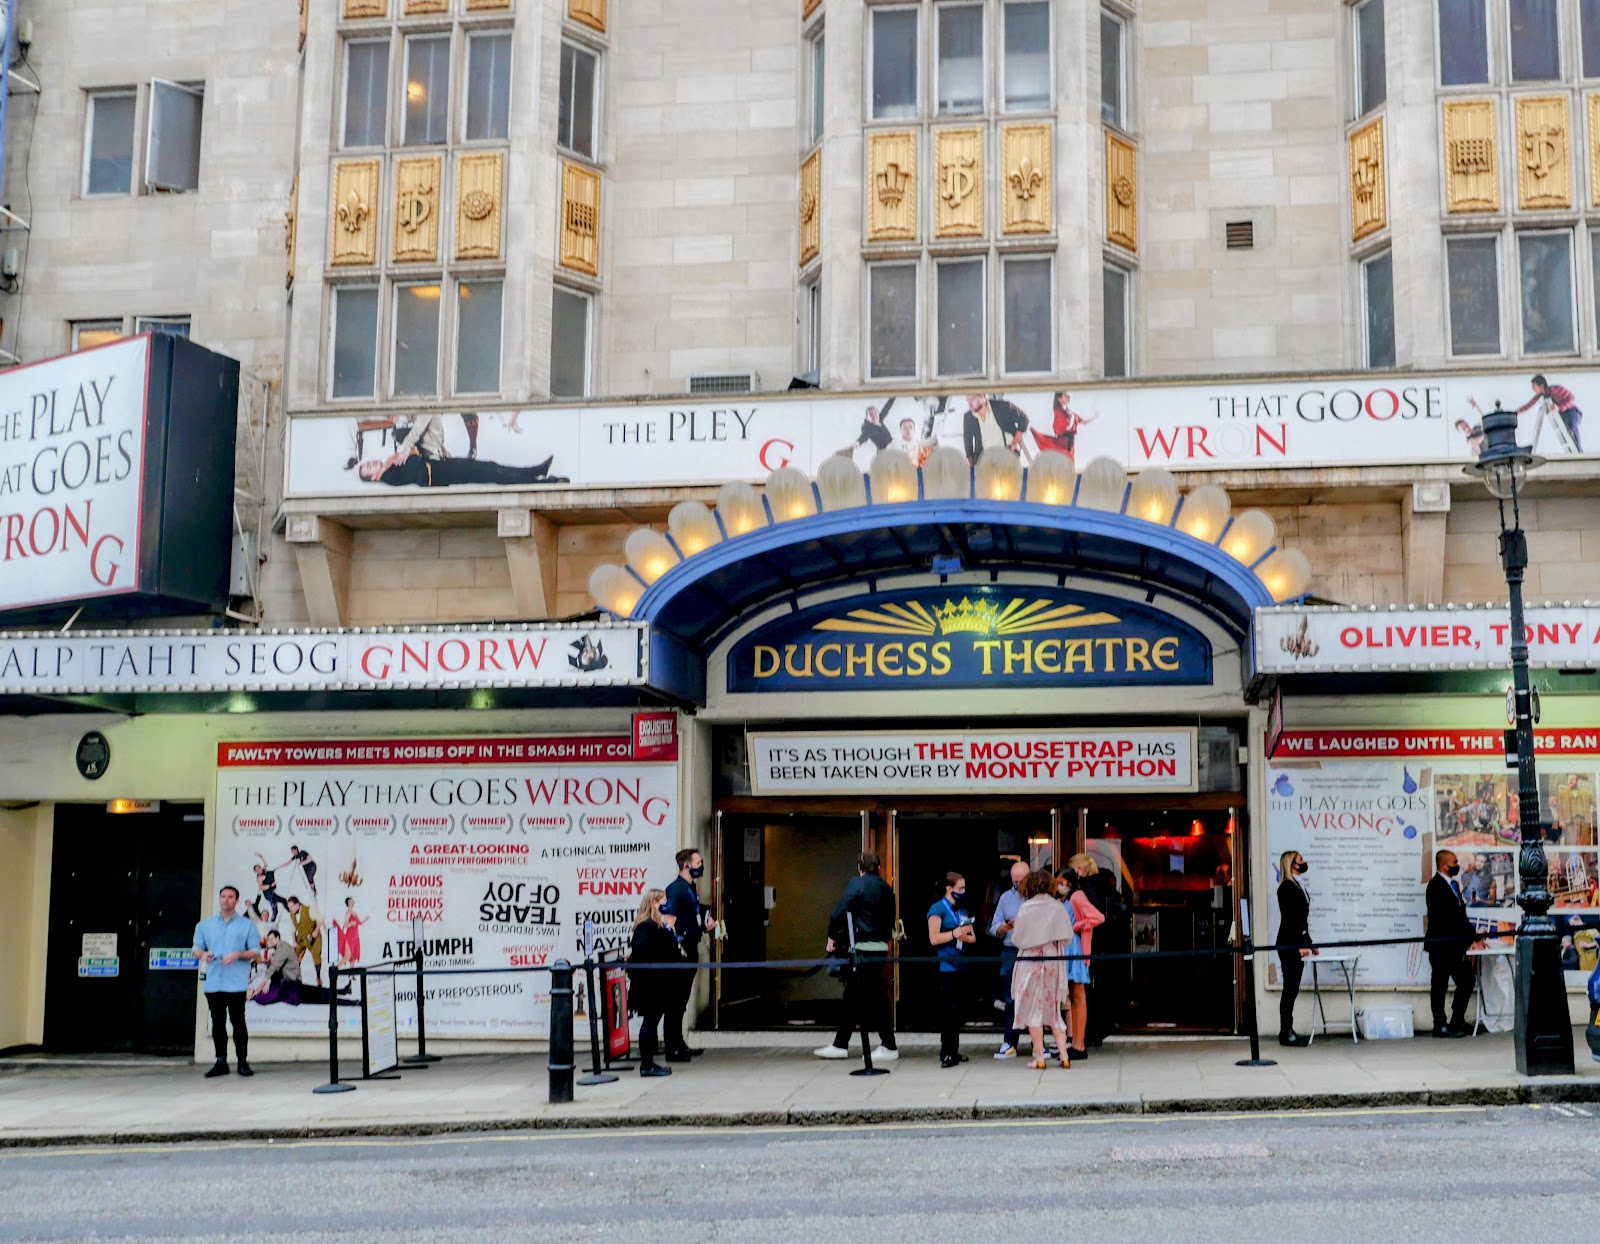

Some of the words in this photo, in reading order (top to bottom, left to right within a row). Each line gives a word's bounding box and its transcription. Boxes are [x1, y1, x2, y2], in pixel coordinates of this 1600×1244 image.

[30, 375, 116, 441] PLAY
[1210, 396, 1289, 419] THAT
[1296, 386, 1442, 422] GOOSE
[603, 423, 657, 444] THE
[668, 408, 758, 442] PLEY
[31, 430, 133, 495] GOES
[0, 499, 124, 587] RONG
[1340, 625, 1480, 650] OLIVIER,
[2, 645, 73, 678] ALP
[91, 643, 207, 677] TAHT
[225, 641, 339, 676] SEOG
[360, 637, 549, 680] GNORW
[753, 641, 952, 678] DUCHESS
[974, 637, 1180, 676] THEATRE
[1319, 736, 1399, 750] LAUGHED
[1404, 736, 1455, 749] UNTIL
[1460, 735, 1494, 749] THE
[1498, 735, 1555, 749] TRS
[1560, 735, 1597, 749] RAN
[227, 749, 282, 761] FAWLTY
[285, 747, 343, 760] TOWERS
[346, 747, 391, 759] MEETS
[394, 746, 444, 758] NOISES
[447, 745, 475, 758] OFF
[478, 745, 493, 757] IN
[497, 745, 524, 757] THE
[527, 744, 576, 757] SMASH
[580, 744, 602, 756] HIT
[804, 748, 828, 762] AS
[831, 747, 911, 762] THOUGH
[914, 743, 965, 761] THE
[970, 741, 1134, 760] MOUSETRAP
[1137, 741, 1176, 757] HAS
[769, 765, 816, 780] BEEN
[821, 765, 878, 779] TAKEN
[883, 764, 932, 779] OVER
[937, 764, 960, 778] BY
[965, 761, 1059, 780] MONTY
[1067, 759, 1176, 778] PYTHON
[229, 786, 276, 806] THE
[283, 779, 354, 807] PLAY
[359, 783, 424, 804] THAT
[430, 778, 517, 807] GOES
[525, 776, 670, 827] WRONG
[1299, 795, 1340, 811] PLAY
[1343, 800, 1373, 811] THAT
[1377, 795, 1427, 812] GOES
[239, 819, 275, 827] WINNER
[295, 819, 332, 827] WINNER
[352, 818, 389, 827] WINNER
[410, 817, 448, 826] WINNER
[468, 816, 506, 826] WINNER
[526, 816, 565, 826] WINNER
[586, 816, 625, 825] WINNER
[1299, 812, 1394, 836] WRONG
[411, 845, 420, 854] A
[423, 844, 530, 855] GREAT-LOOKING
[541, 848, 548, 858] A
[551, 844, 607, 858] TECHNICAL
[609, 842, 651, 854] TRIUMPH
[410, 857, 455, 866] BRILLIANTLY
[457, 856, 503, 865] PERFORMED
[504, 856, 528, 865] PIECE
[389, 875, 397, 887] A
[399, 874, 443, 887] JOYOUS
[576, 867, 607, 879] VERY
[610, 867, 648, 879] VERY
[482, 882, 526, 903] JOY
[530, 884, 560, 905] OF
[578, 881, 646, 895] FUNNY
[388, 897, 443, 909] DELIRIOUS
[387, 910, 443, 922] CLIMAX
[479, 903, 561, 926] TEARS
[478, 924, 490, 933] TO
[493, 925, 534, 935] REDUCED
[536, 927, 555, 936] WAS
[382, 941, 393, 958] A
[396, 938, 474, 958] TRUMPH
[510, 954, 548, 966] SILLY
[438, 982, 524, 999] PREPOSTEROUS
